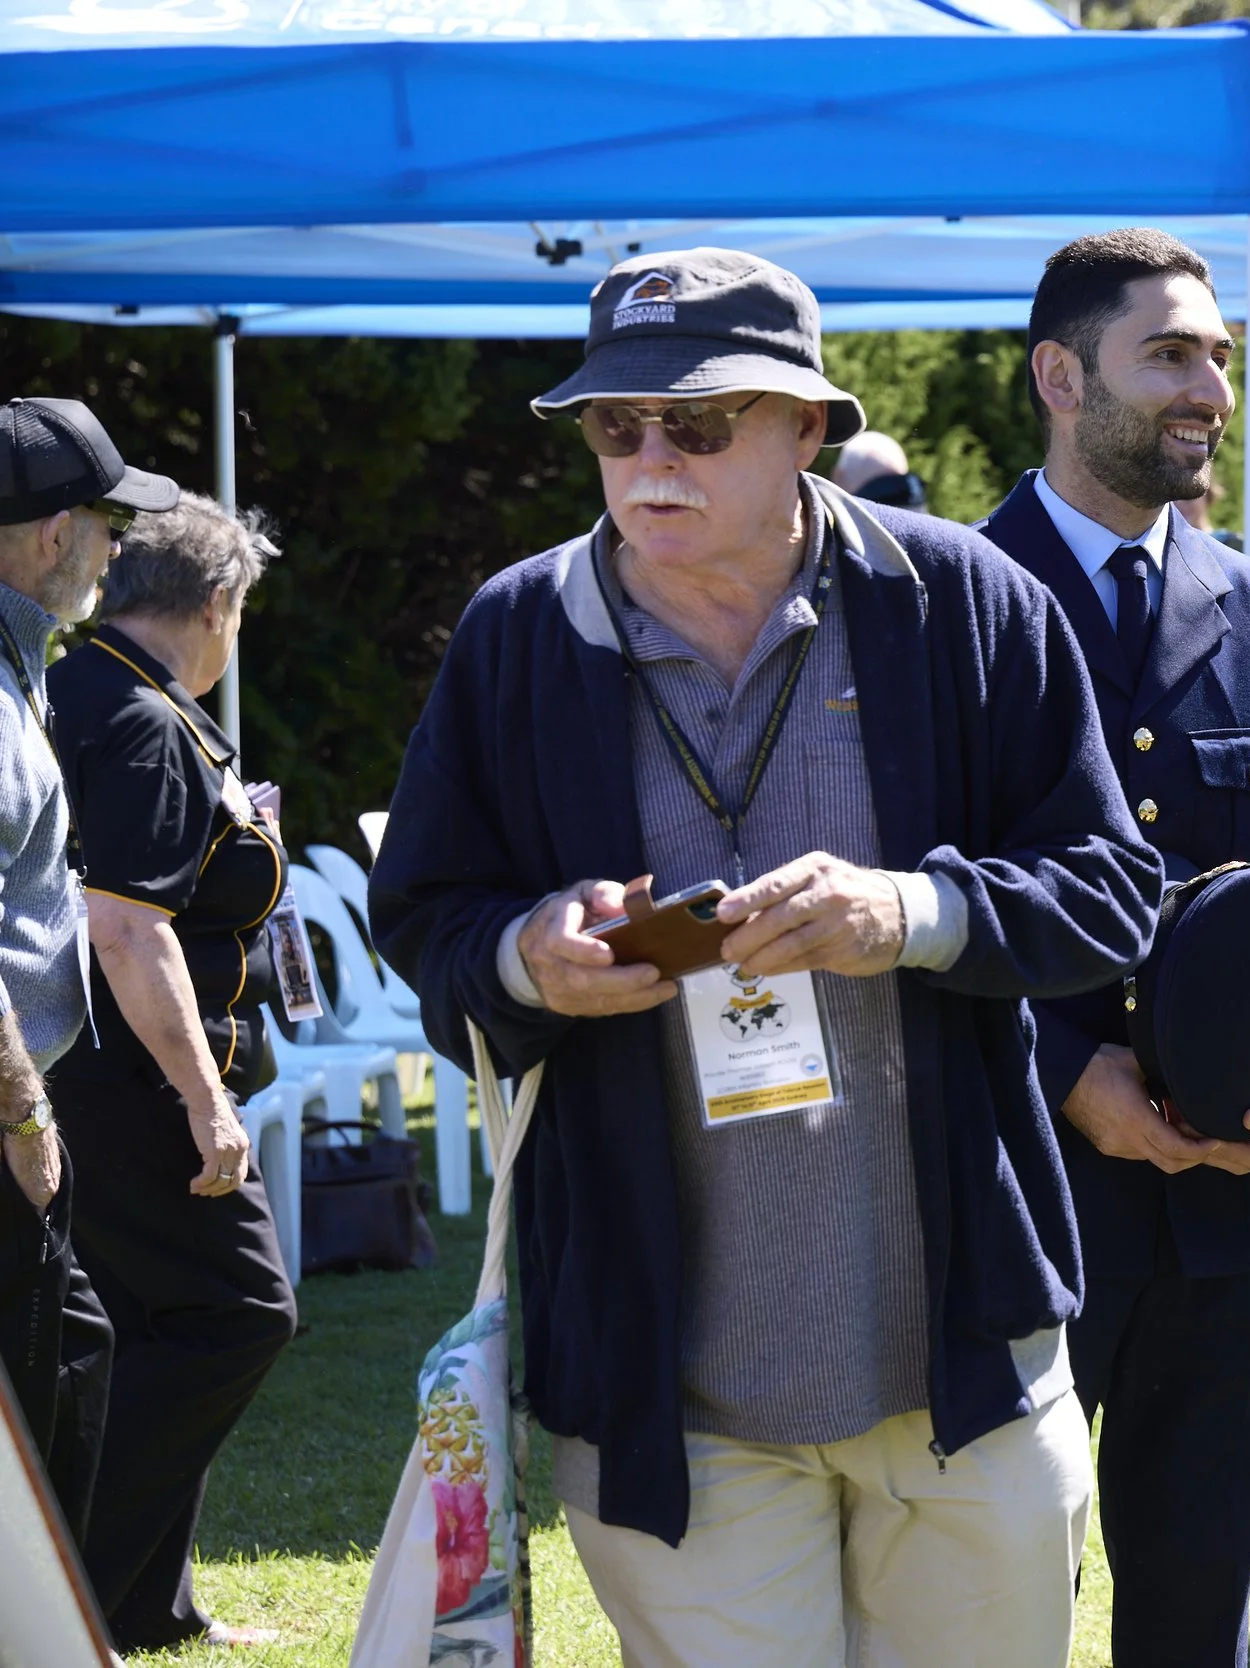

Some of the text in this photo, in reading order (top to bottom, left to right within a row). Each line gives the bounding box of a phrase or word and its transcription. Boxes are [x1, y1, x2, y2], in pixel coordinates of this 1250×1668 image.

[613, 304, 676, 321] STOCKYARD
[612, 315, 676, 331] INDUSTRIES
[728, 1041, 801, 1061] Norman Smith
